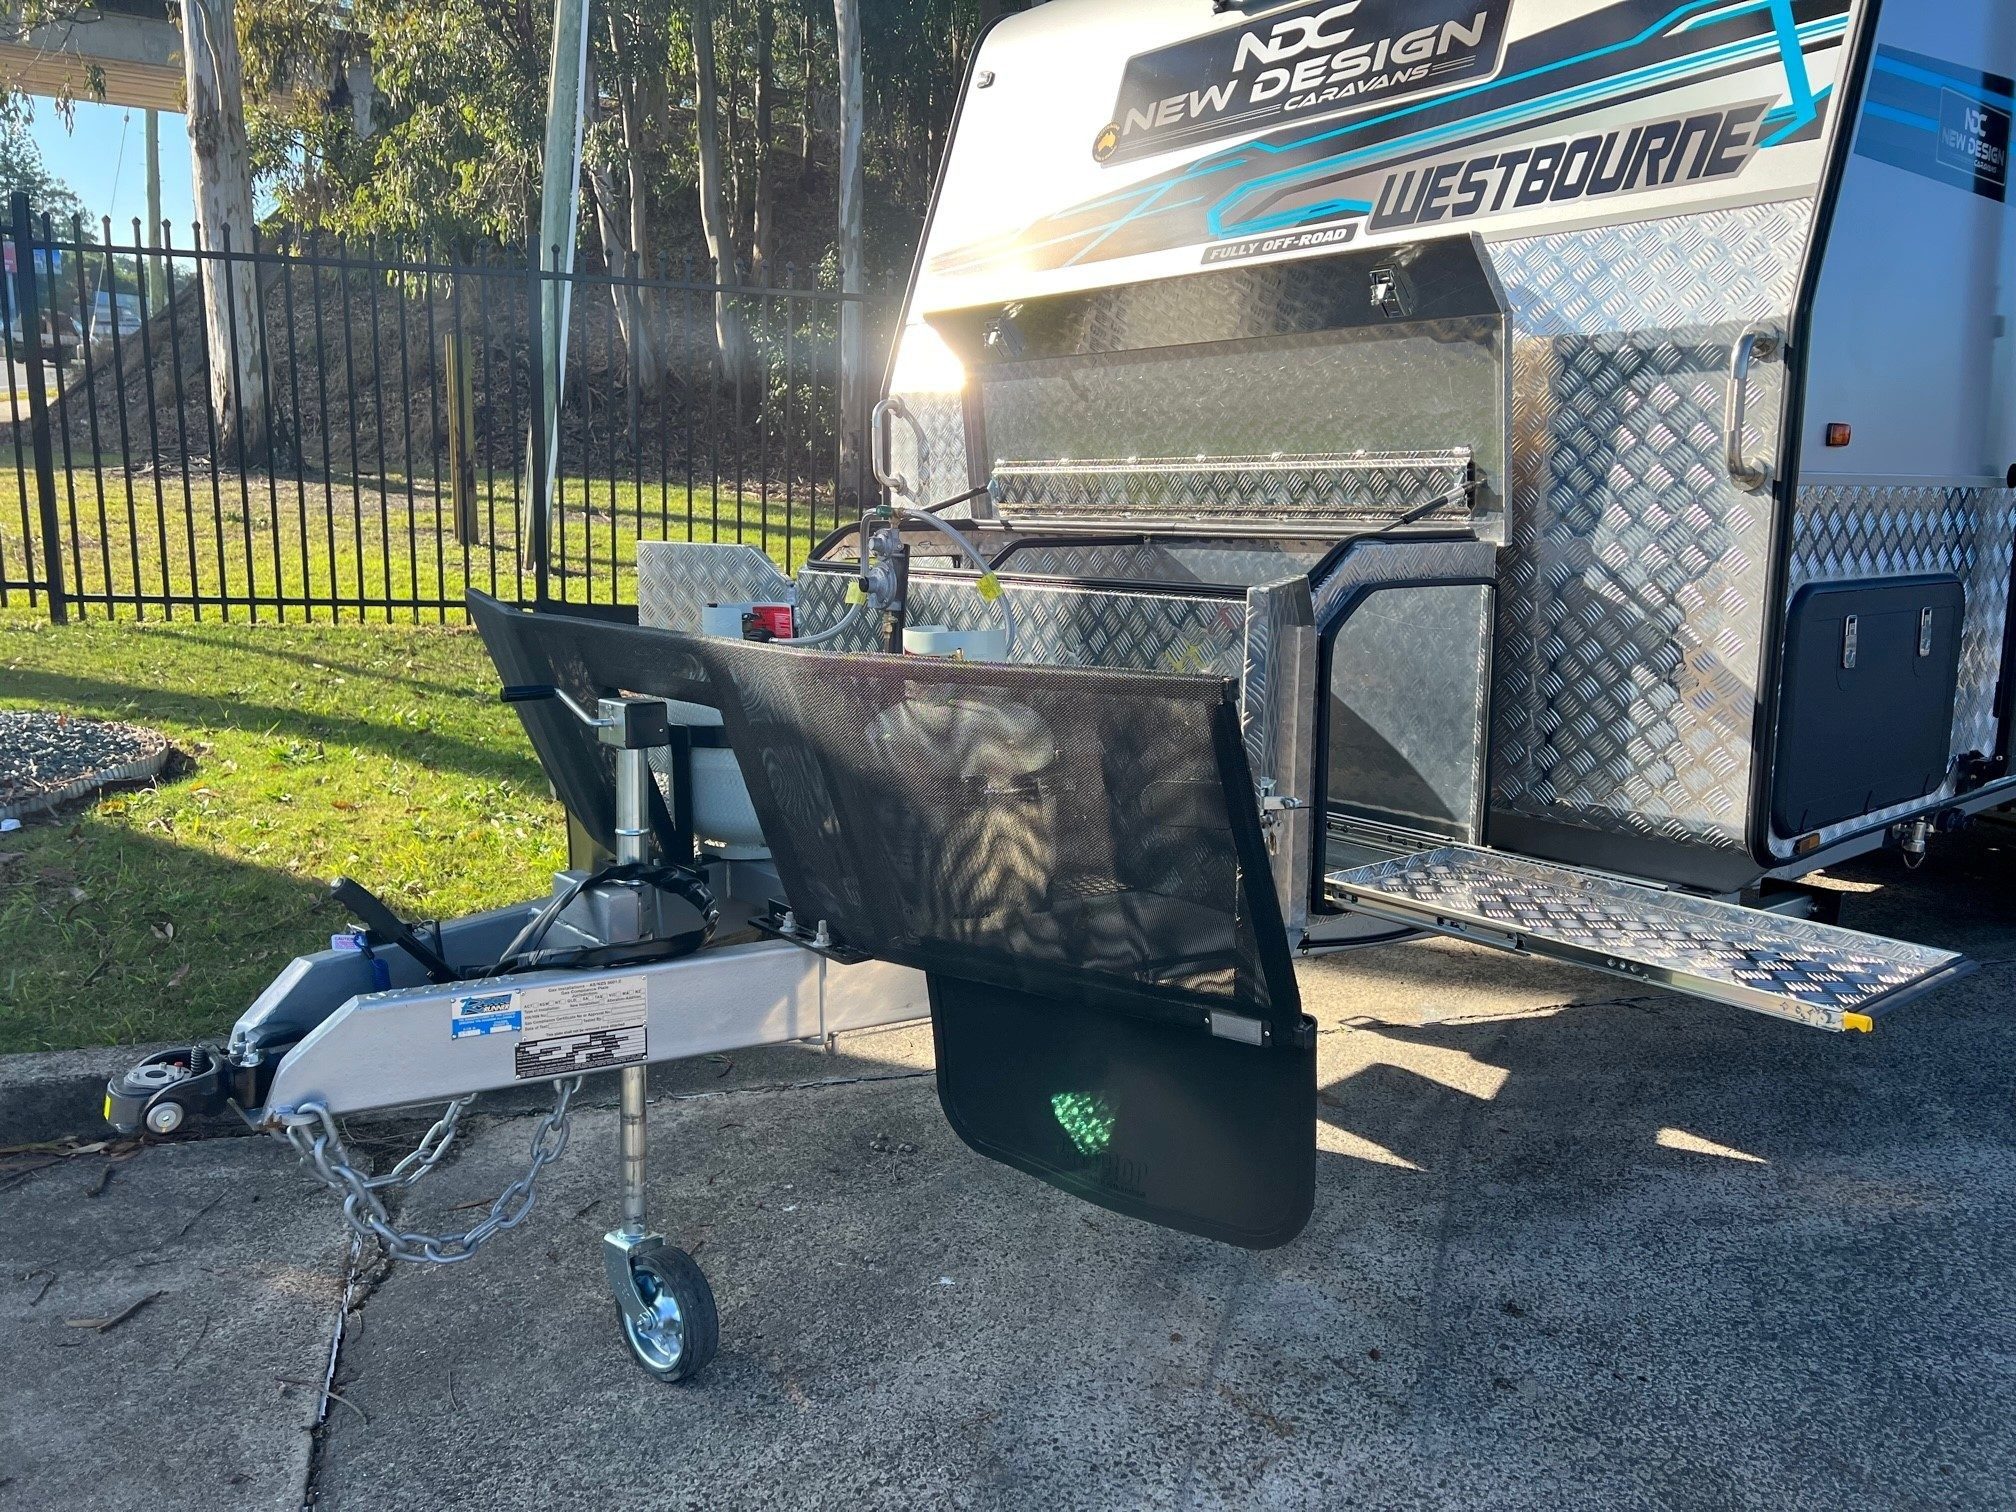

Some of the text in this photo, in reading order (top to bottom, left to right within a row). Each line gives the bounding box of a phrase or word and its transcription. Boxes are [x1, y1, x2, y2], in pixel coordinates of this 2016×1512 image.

[1232, 0, 1361, 72] NDC
[1122, 11, 1488, 136] NEW DESIGN
[1284, 62, 1432, 111] CARAVANS
[1941, 126, 2005, 166] NEW DESIGN
[1964, 107, 1988, 137] NDC
[1370, 102, 1770, 230] WESTBOURNE
[1209, 228, 1348, 260] FULLY OFF-ROAD
